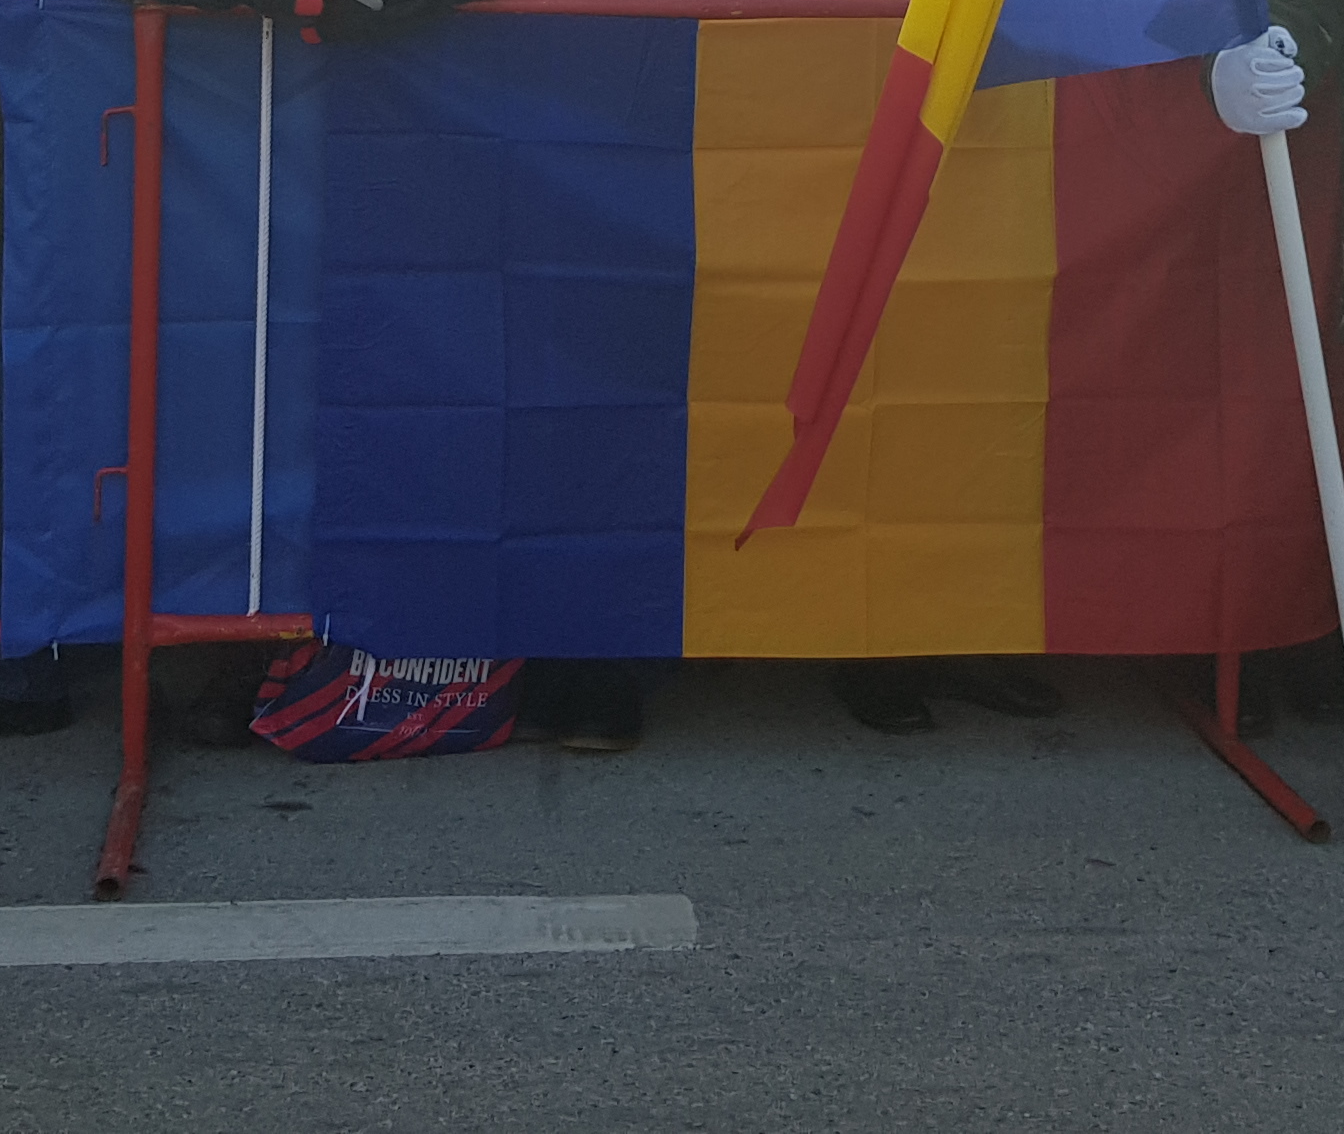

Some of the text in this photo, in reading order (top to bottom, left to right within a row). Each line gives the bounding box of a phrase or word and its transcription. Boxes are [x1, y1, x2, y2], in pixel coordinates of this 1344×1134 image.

[379, 657, 494, 685] CONFIDENT
[345, 685, 489, 708] DESS IN STYLE
